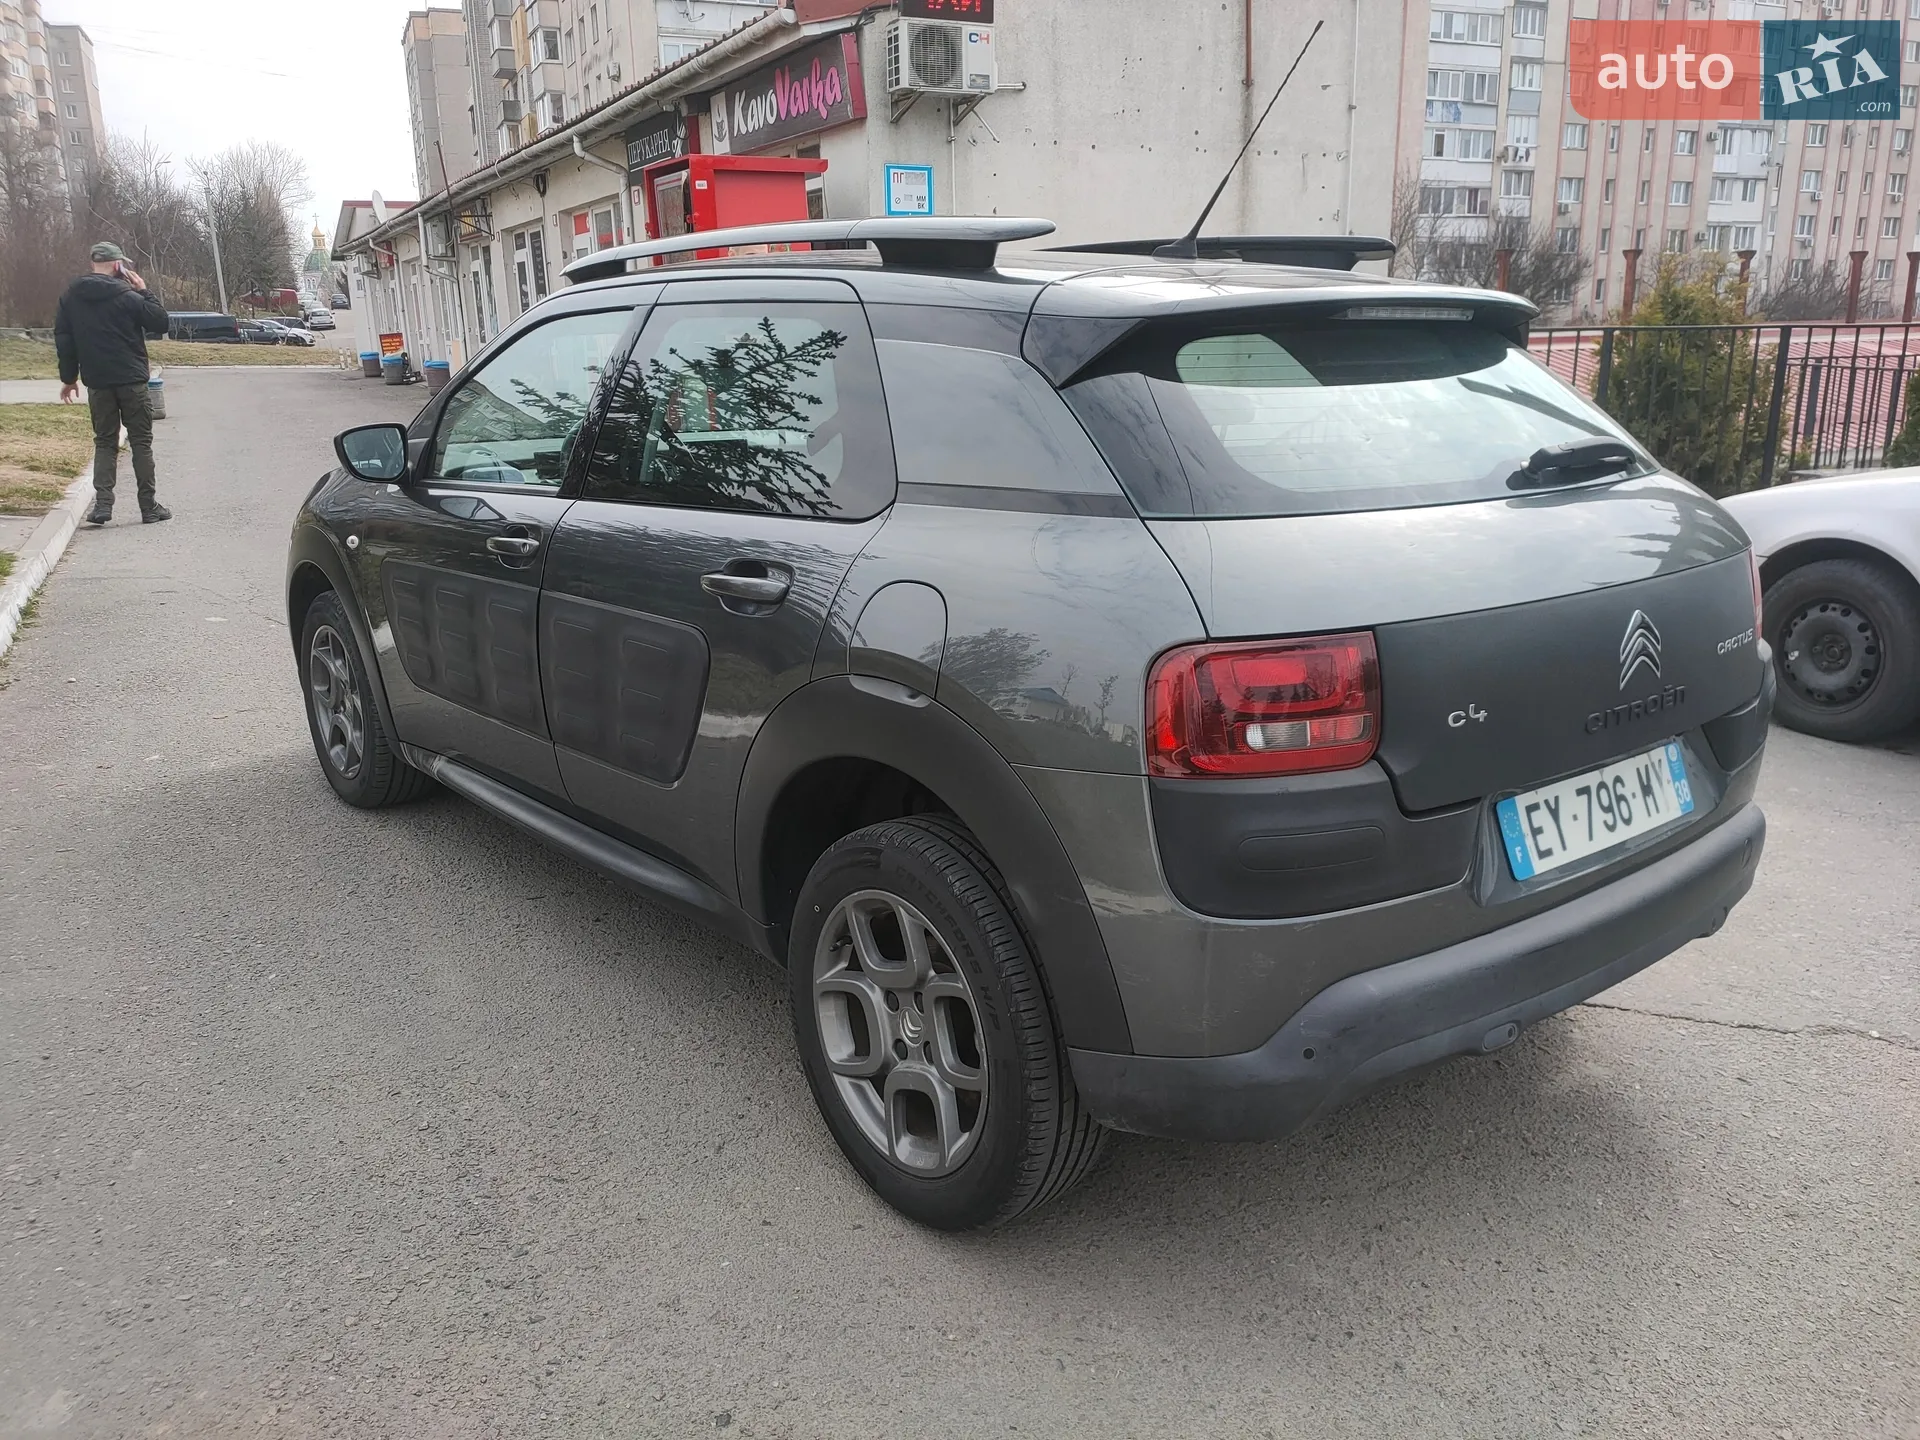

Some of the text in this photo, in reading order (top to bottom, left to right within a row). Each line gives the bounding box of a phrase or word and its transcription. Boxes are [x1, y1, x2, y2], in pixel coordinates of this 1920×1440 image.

[627, 128, 671, 165] ПЕРУКАРНЯ
[892, 171, 905, 184] ПГ
[1717, 628, 1754, 656] CACTUS
[1447, 703, 1488, 728] C4
[1585, 684, 1687, 735] CITROËN
[1674, 778, 1692, 805] 38
[1514, 846, 1523, 864] F
